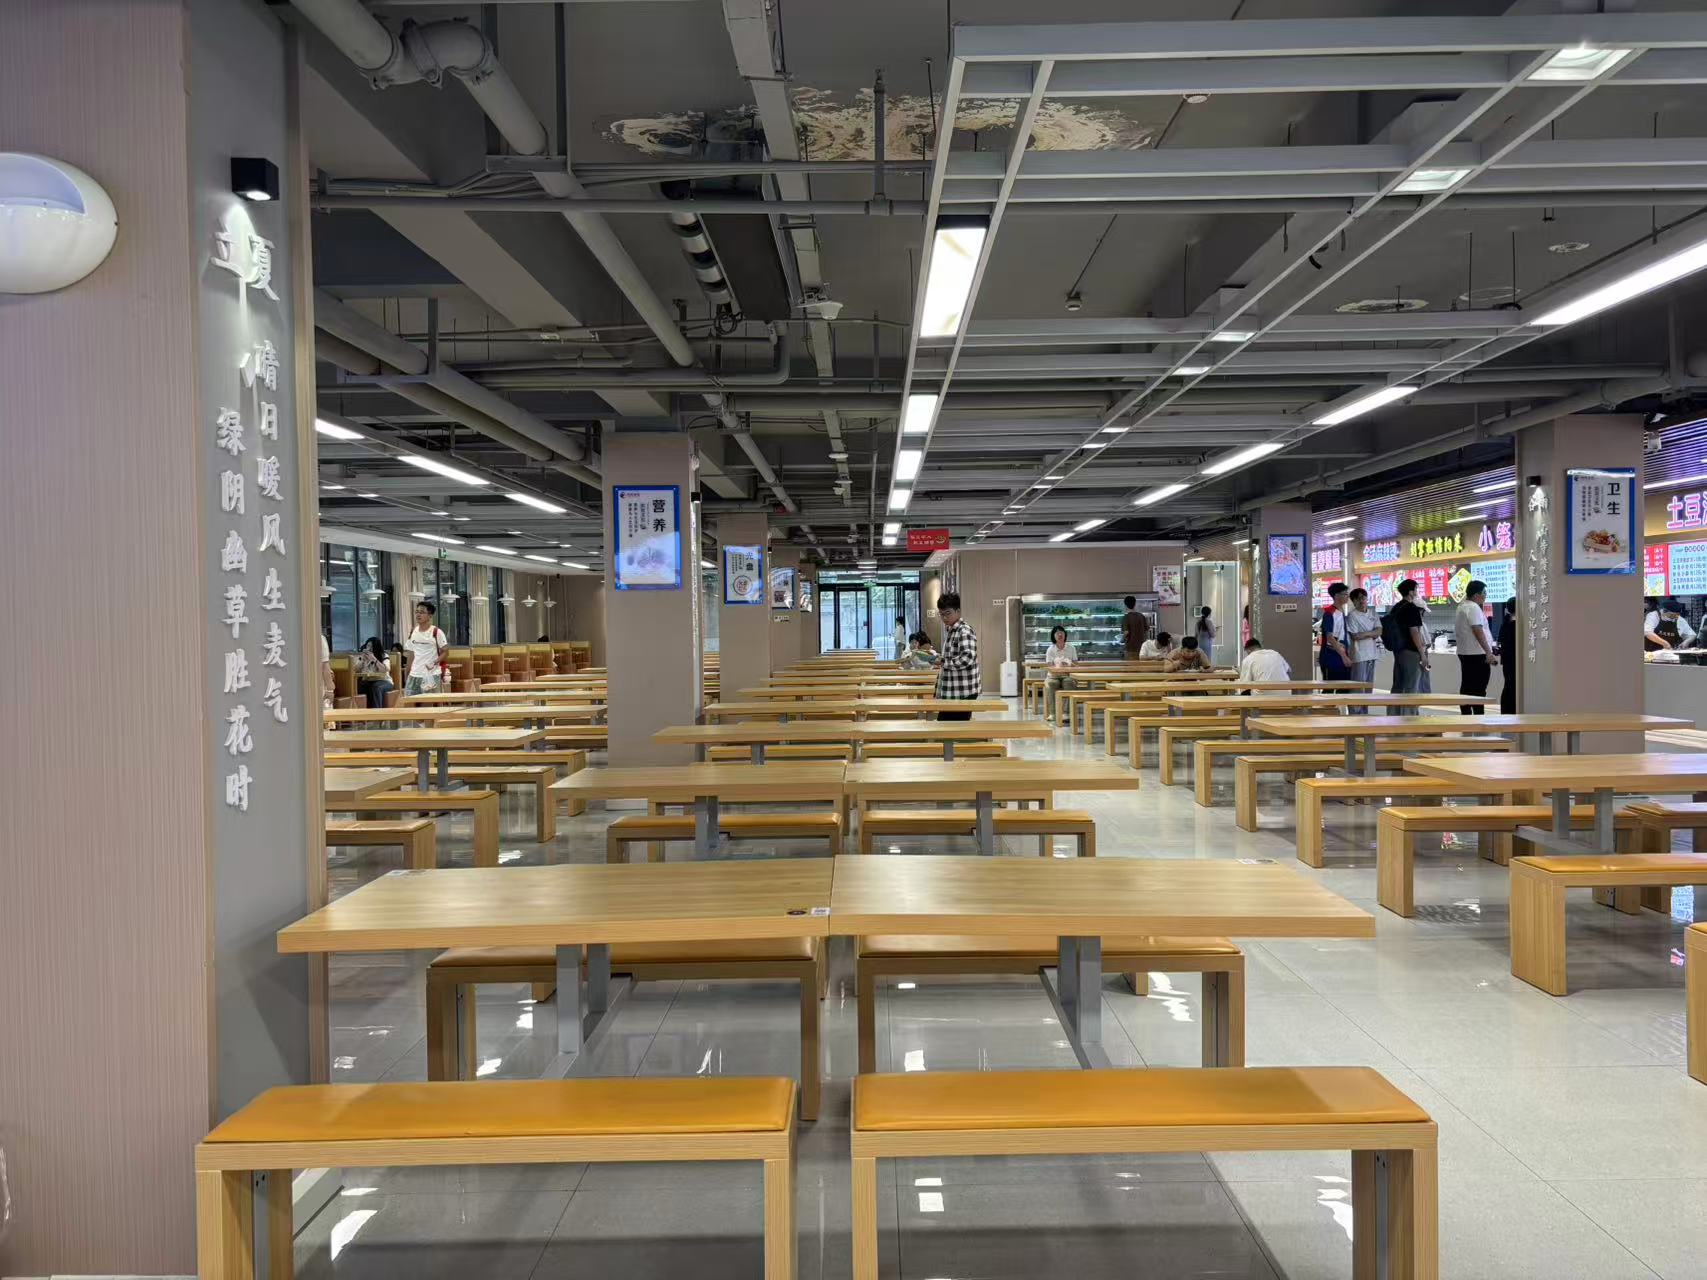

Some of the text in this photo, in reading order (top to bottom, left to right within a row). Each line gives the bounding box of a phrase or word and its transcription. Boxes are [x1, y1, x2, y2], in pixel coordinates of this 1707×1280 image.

[210, 216, 280, 301] 立夏
[652, 499, 666, 532] 营养
[1607, 482, 1621, 515] 卫生
[1667, 494, 1707, 529] 土豆
[254, 339, 289, 724] 晴日暖风生麦气
[745, 552, 754, 571] 光盘
